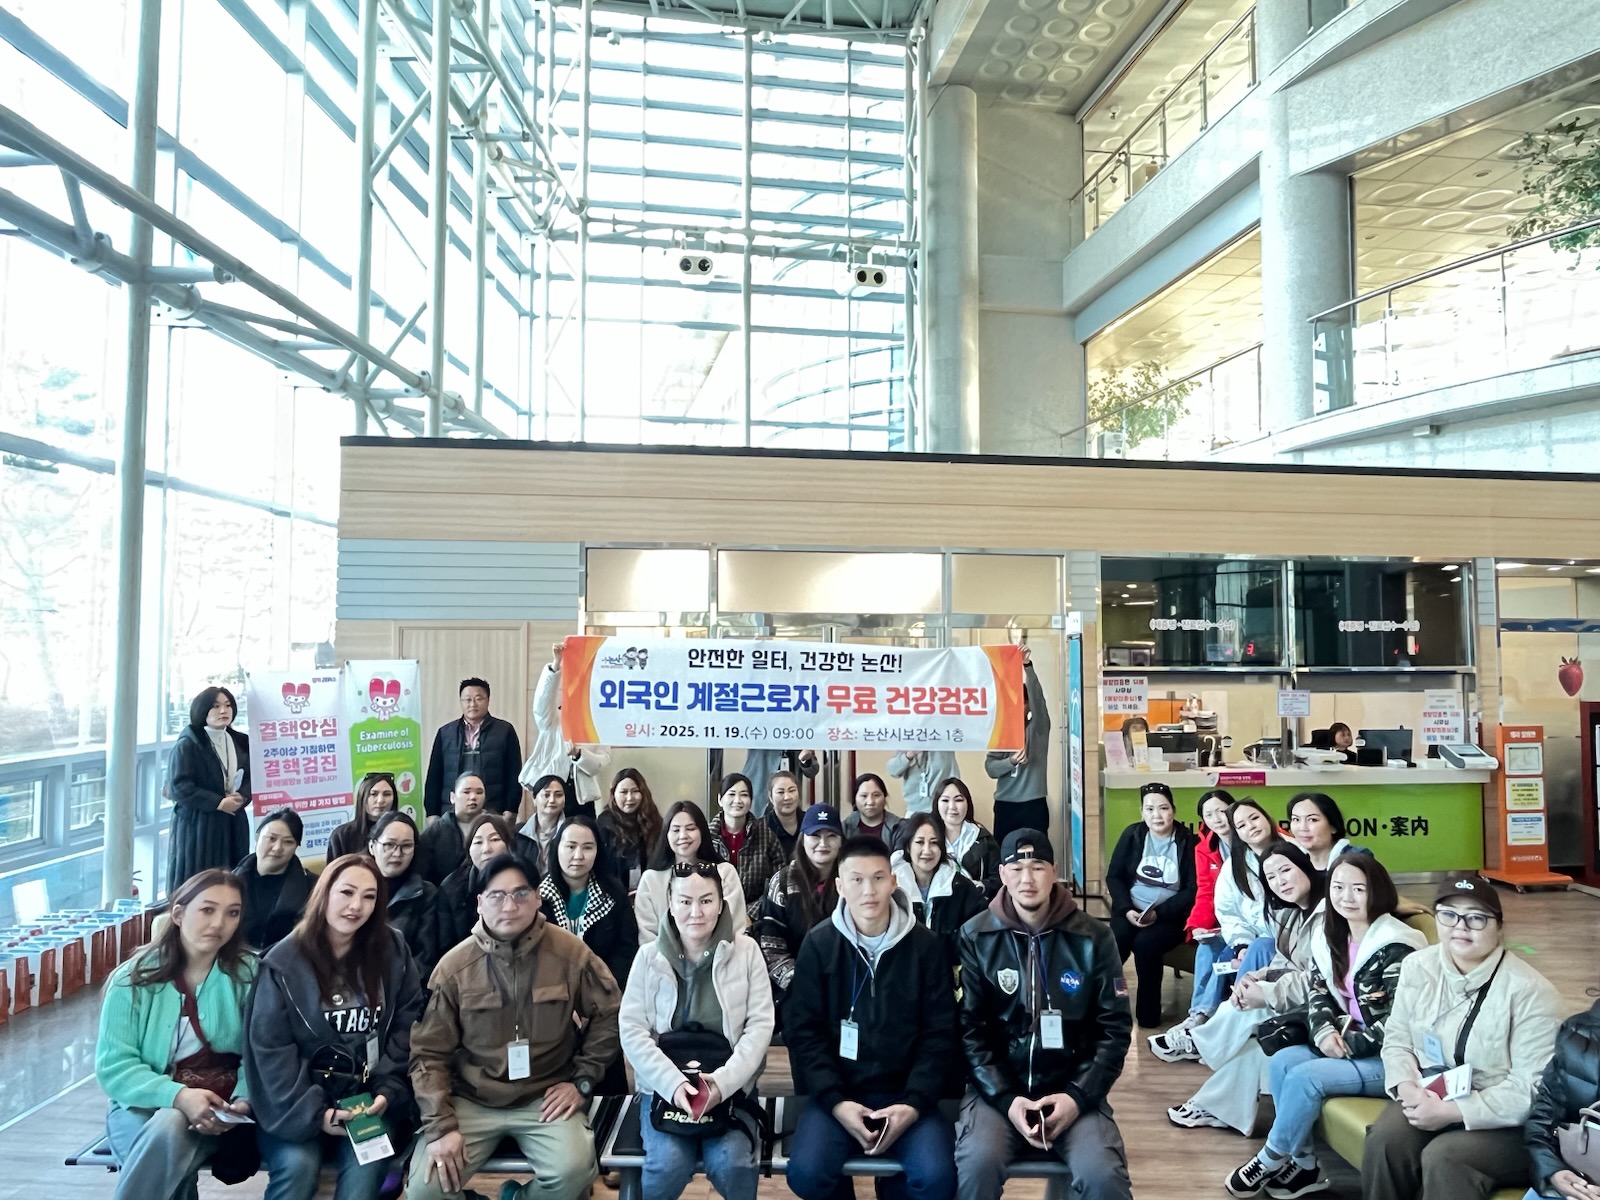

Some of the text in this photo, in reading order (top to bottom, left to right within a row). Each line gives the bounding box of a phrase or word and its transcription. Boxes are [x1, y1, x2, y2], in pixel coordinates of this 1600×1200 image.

[687, 648, 902, 673] 안전한 일터, 건강한 논산!
[598, 679, 988, 716] 외국인 계절근로자 무료 건강검진
[259, 718, 338, 742] 결핵안심
[360, 730, 399, 740] Examine
[624, 723, 655, 738] 일시:
[659, 725, 699, 738] 2025.
[703, 726, 720, 738] 11.
[772, 727, 815, 740] 09:00
[827, 727, 858, 741] 장소:
[862, 728, 942, 742] 논산시보건소
[946, 729, 964, 742] 1층
[263, 743, 336, 758] 2주이상 기침하면
[356, 740, 414, 753] Tuberculosis
[264, 754, 338, 778] 결핵검진
[1454, 879, 1475, 890] alo
